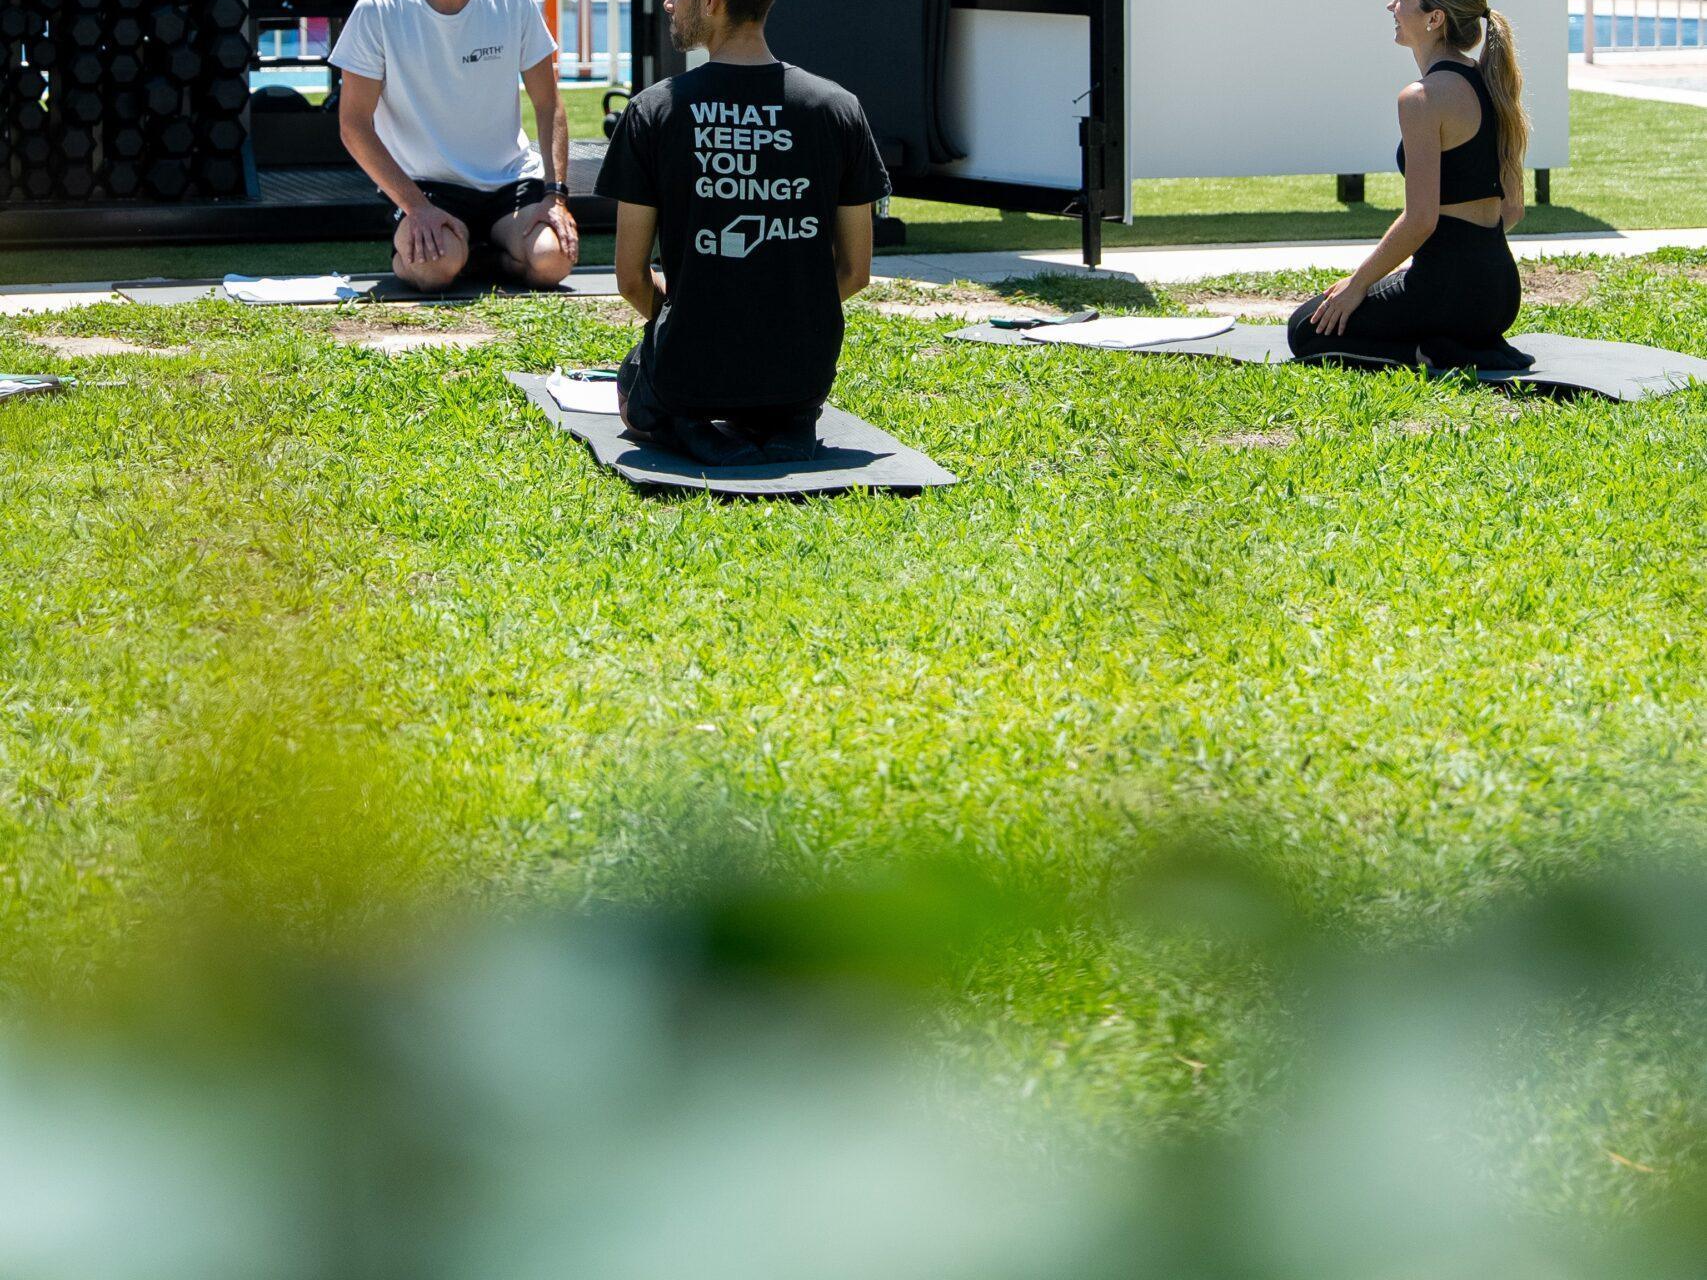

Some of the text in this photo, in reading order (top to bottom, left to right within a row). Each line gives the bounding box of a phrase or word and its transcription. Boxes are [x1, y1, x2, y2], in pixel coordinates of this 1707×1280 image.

[690, 102, 783, 126] WHAT
[694, 127, 793, 151] KEEPS
[694, 152, 757, 176] YOU
[695, 176, 810, 200] GOING?
